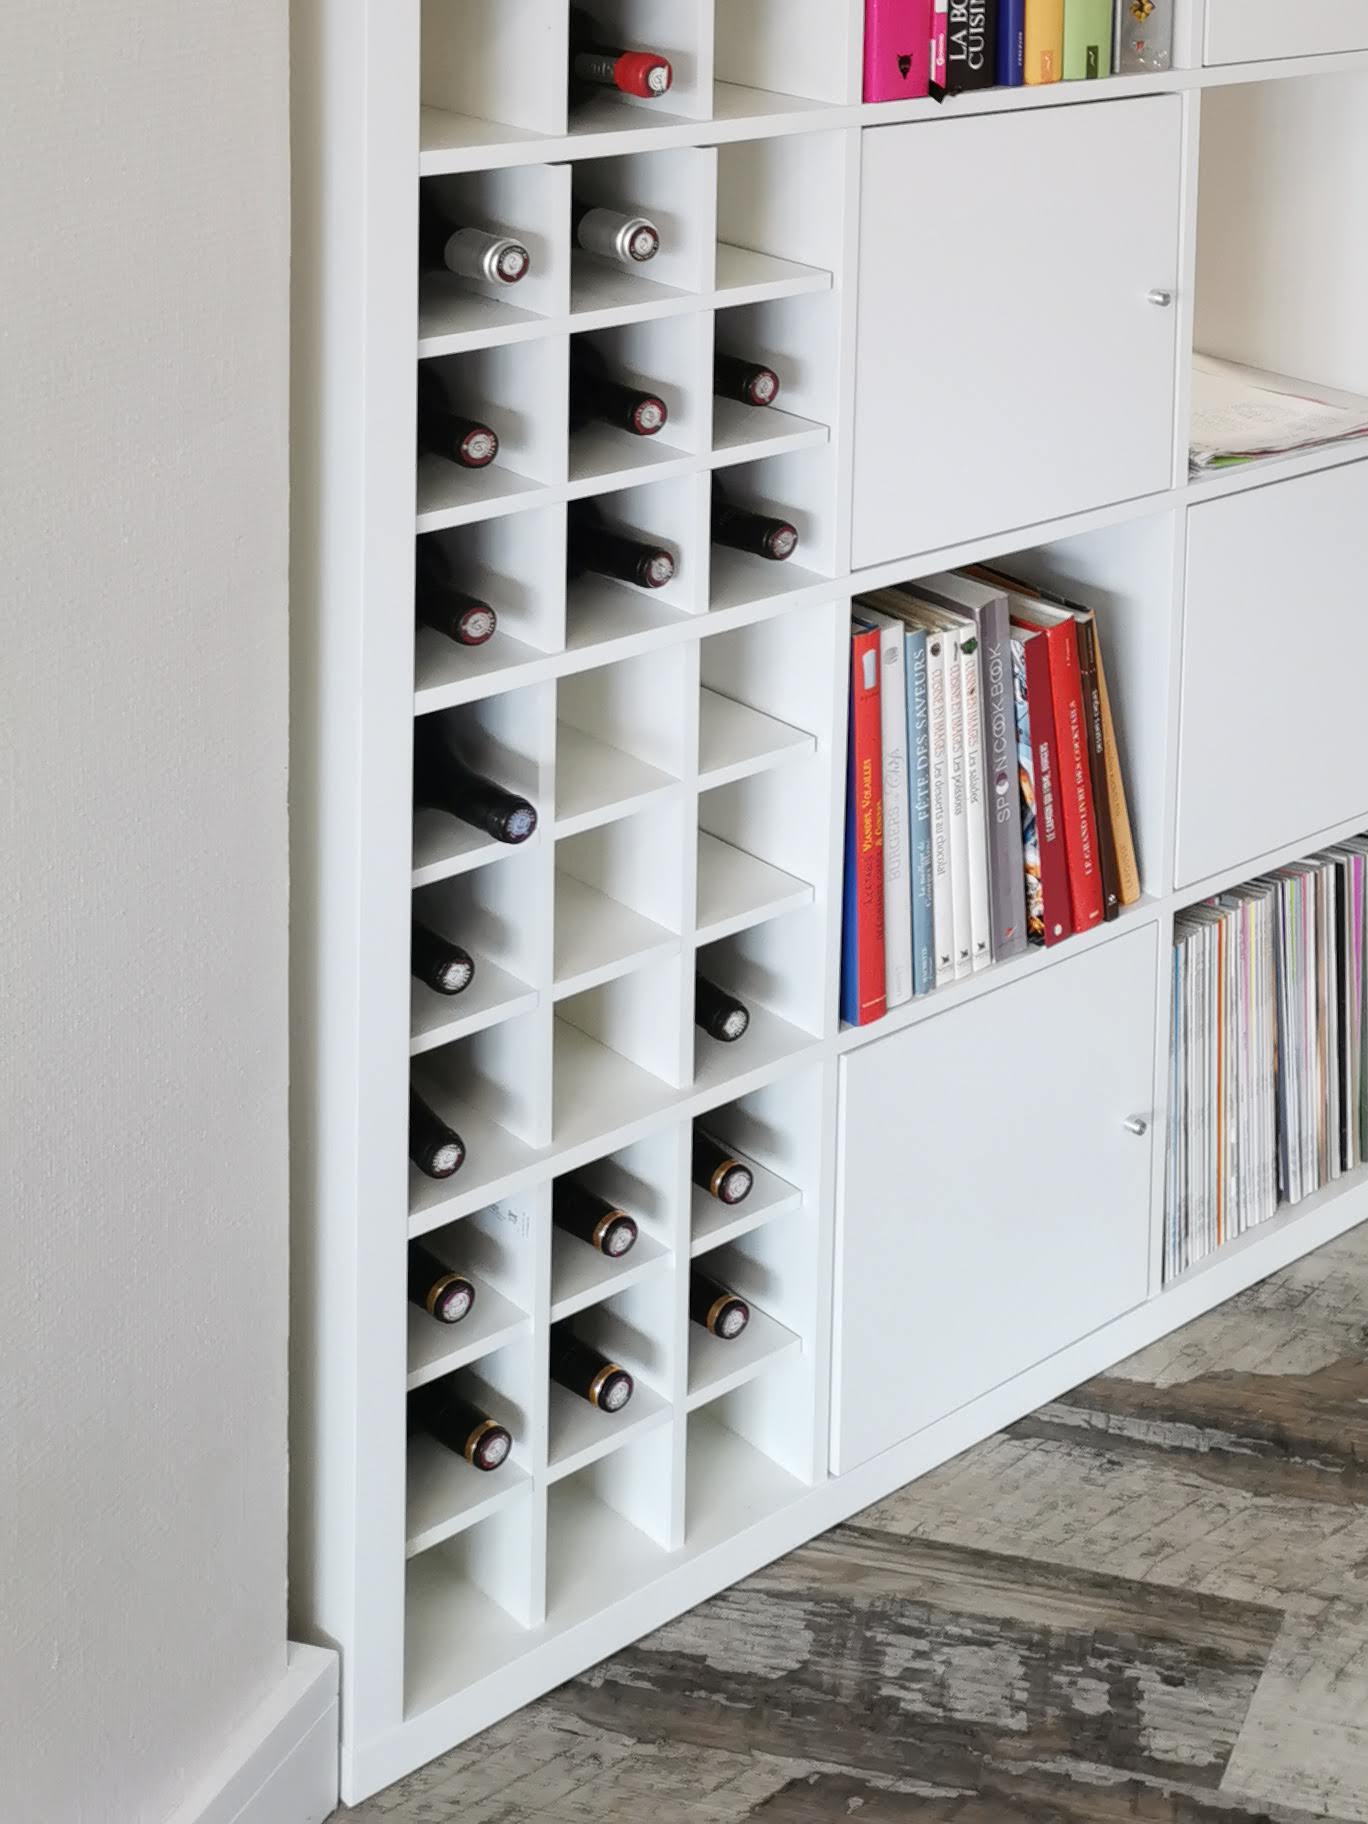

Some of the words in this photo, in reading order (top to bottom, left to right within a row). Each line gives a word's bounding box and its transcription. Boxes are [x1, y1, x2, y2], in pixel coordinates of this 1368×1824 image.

[950, 30, 967, 60] LA
[988, 643, 1004, 696] BOOK
[913, 649, 927, 729] SAVEURS
[991, 697, 1008, 753] COOK
[916, 734, 928, 770] DES
[934, 760, 944, 778] Les
[953, 755, 961, 772] Les
[968, 750, 978, 767] Les
[915, 775, 929, 821] FÊTE
[934, 780, 945, 820] desserts
[952, 774, 962, 816] poissons
[968, 769, 978, 804] salades
[1077, 785, 1087, 819] LIVRE
[936, 822, 944, 834] au
[1081, 819, 1091, 859] GRAND
[937, 835, 947, 876] chocolat
